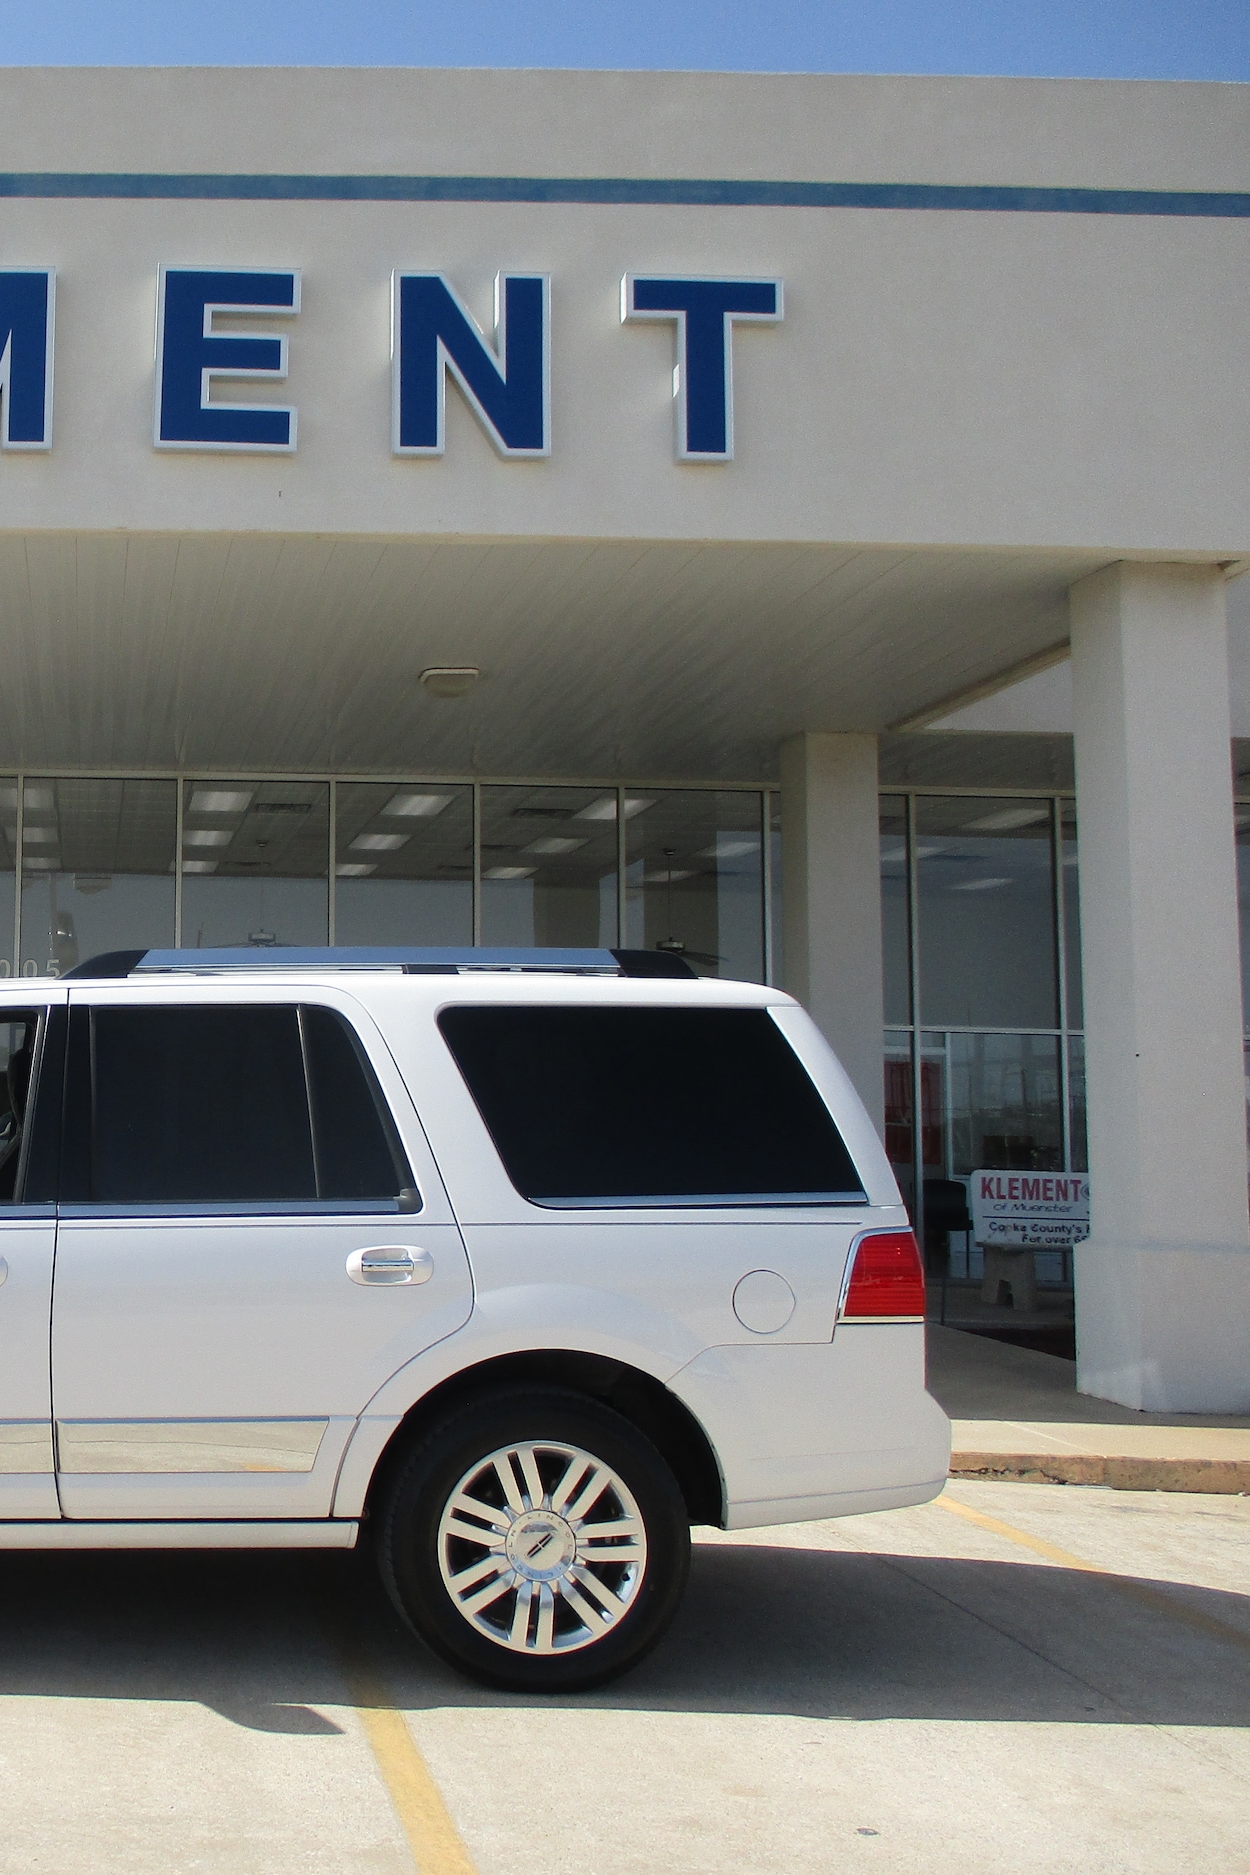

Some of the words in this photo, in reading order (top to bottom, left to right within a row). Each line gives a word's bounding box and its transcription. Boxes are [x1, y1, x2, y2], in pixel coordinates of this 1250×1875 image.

[981, 1177, 1081, 1201] KLEMENT
[993, 1203, 1007, 1211] of
[1010, 1203, 1073, 1213] Muenster
[988, 1221, 1027, 1232] Coke
[1030, 1223, 1082, 1235] County's
